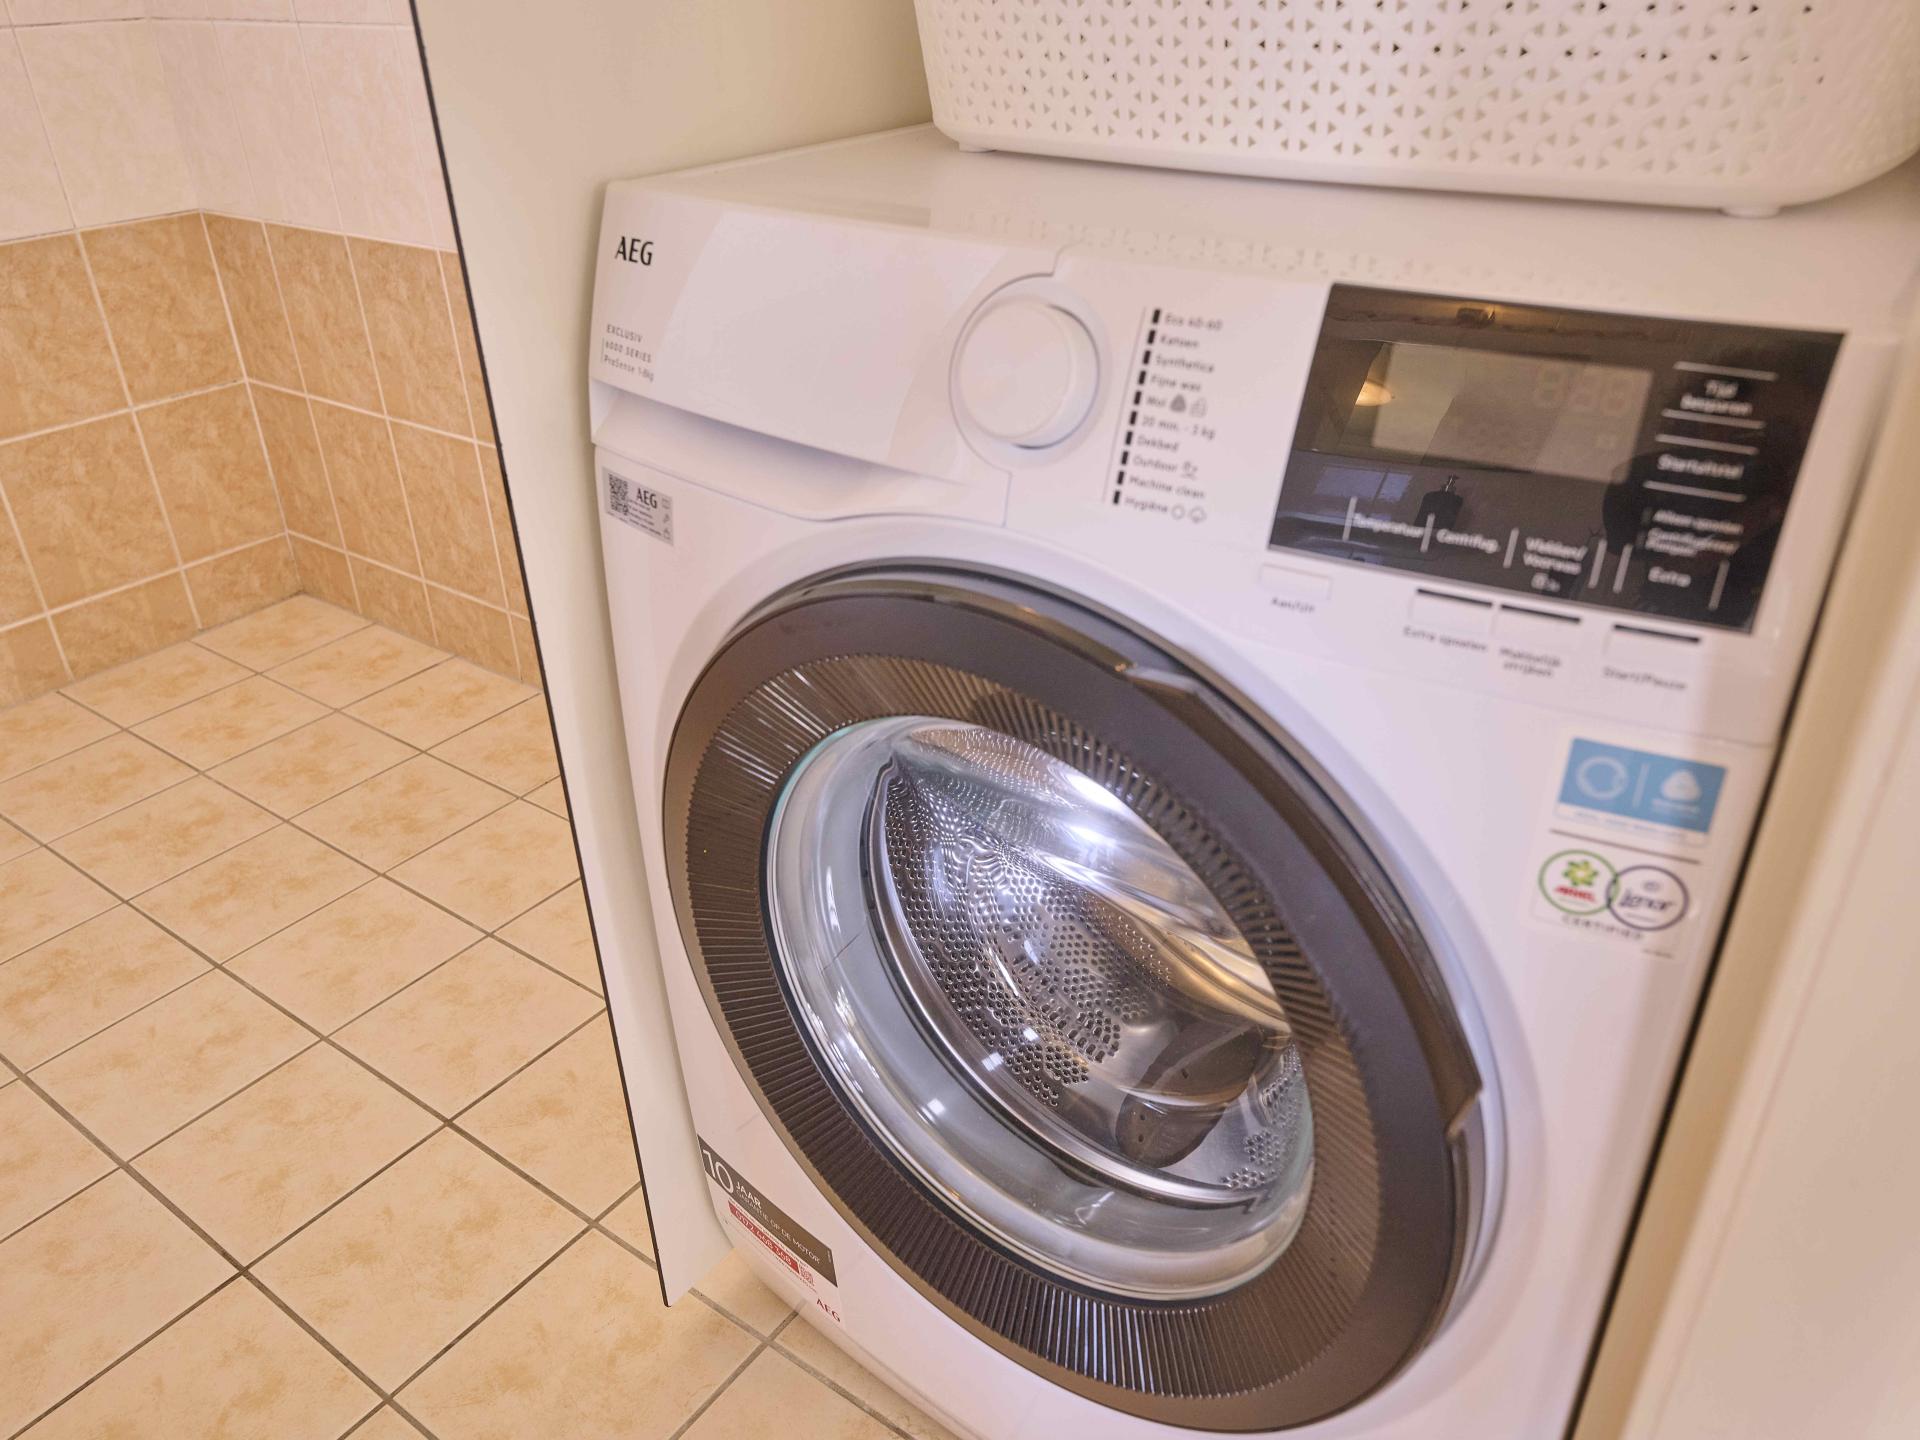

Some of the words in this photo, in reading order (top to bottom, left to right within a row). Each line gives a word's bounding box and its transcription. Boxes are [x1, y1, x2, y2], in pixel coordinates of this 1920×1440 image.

[614, 236, 654, 266] AEG
[606, 323, 643, 343] EXCLUSIV
[625, 346, 652, 364] SERIES
[636, 487, 658, 509] AEG
[702, 1148, 734, 1194] 10
[735, 1180, 762, 1210] JAAR
[792, 1237, 821, 1265] MOTOR
[815, 1297, 841, 1323] AEG
